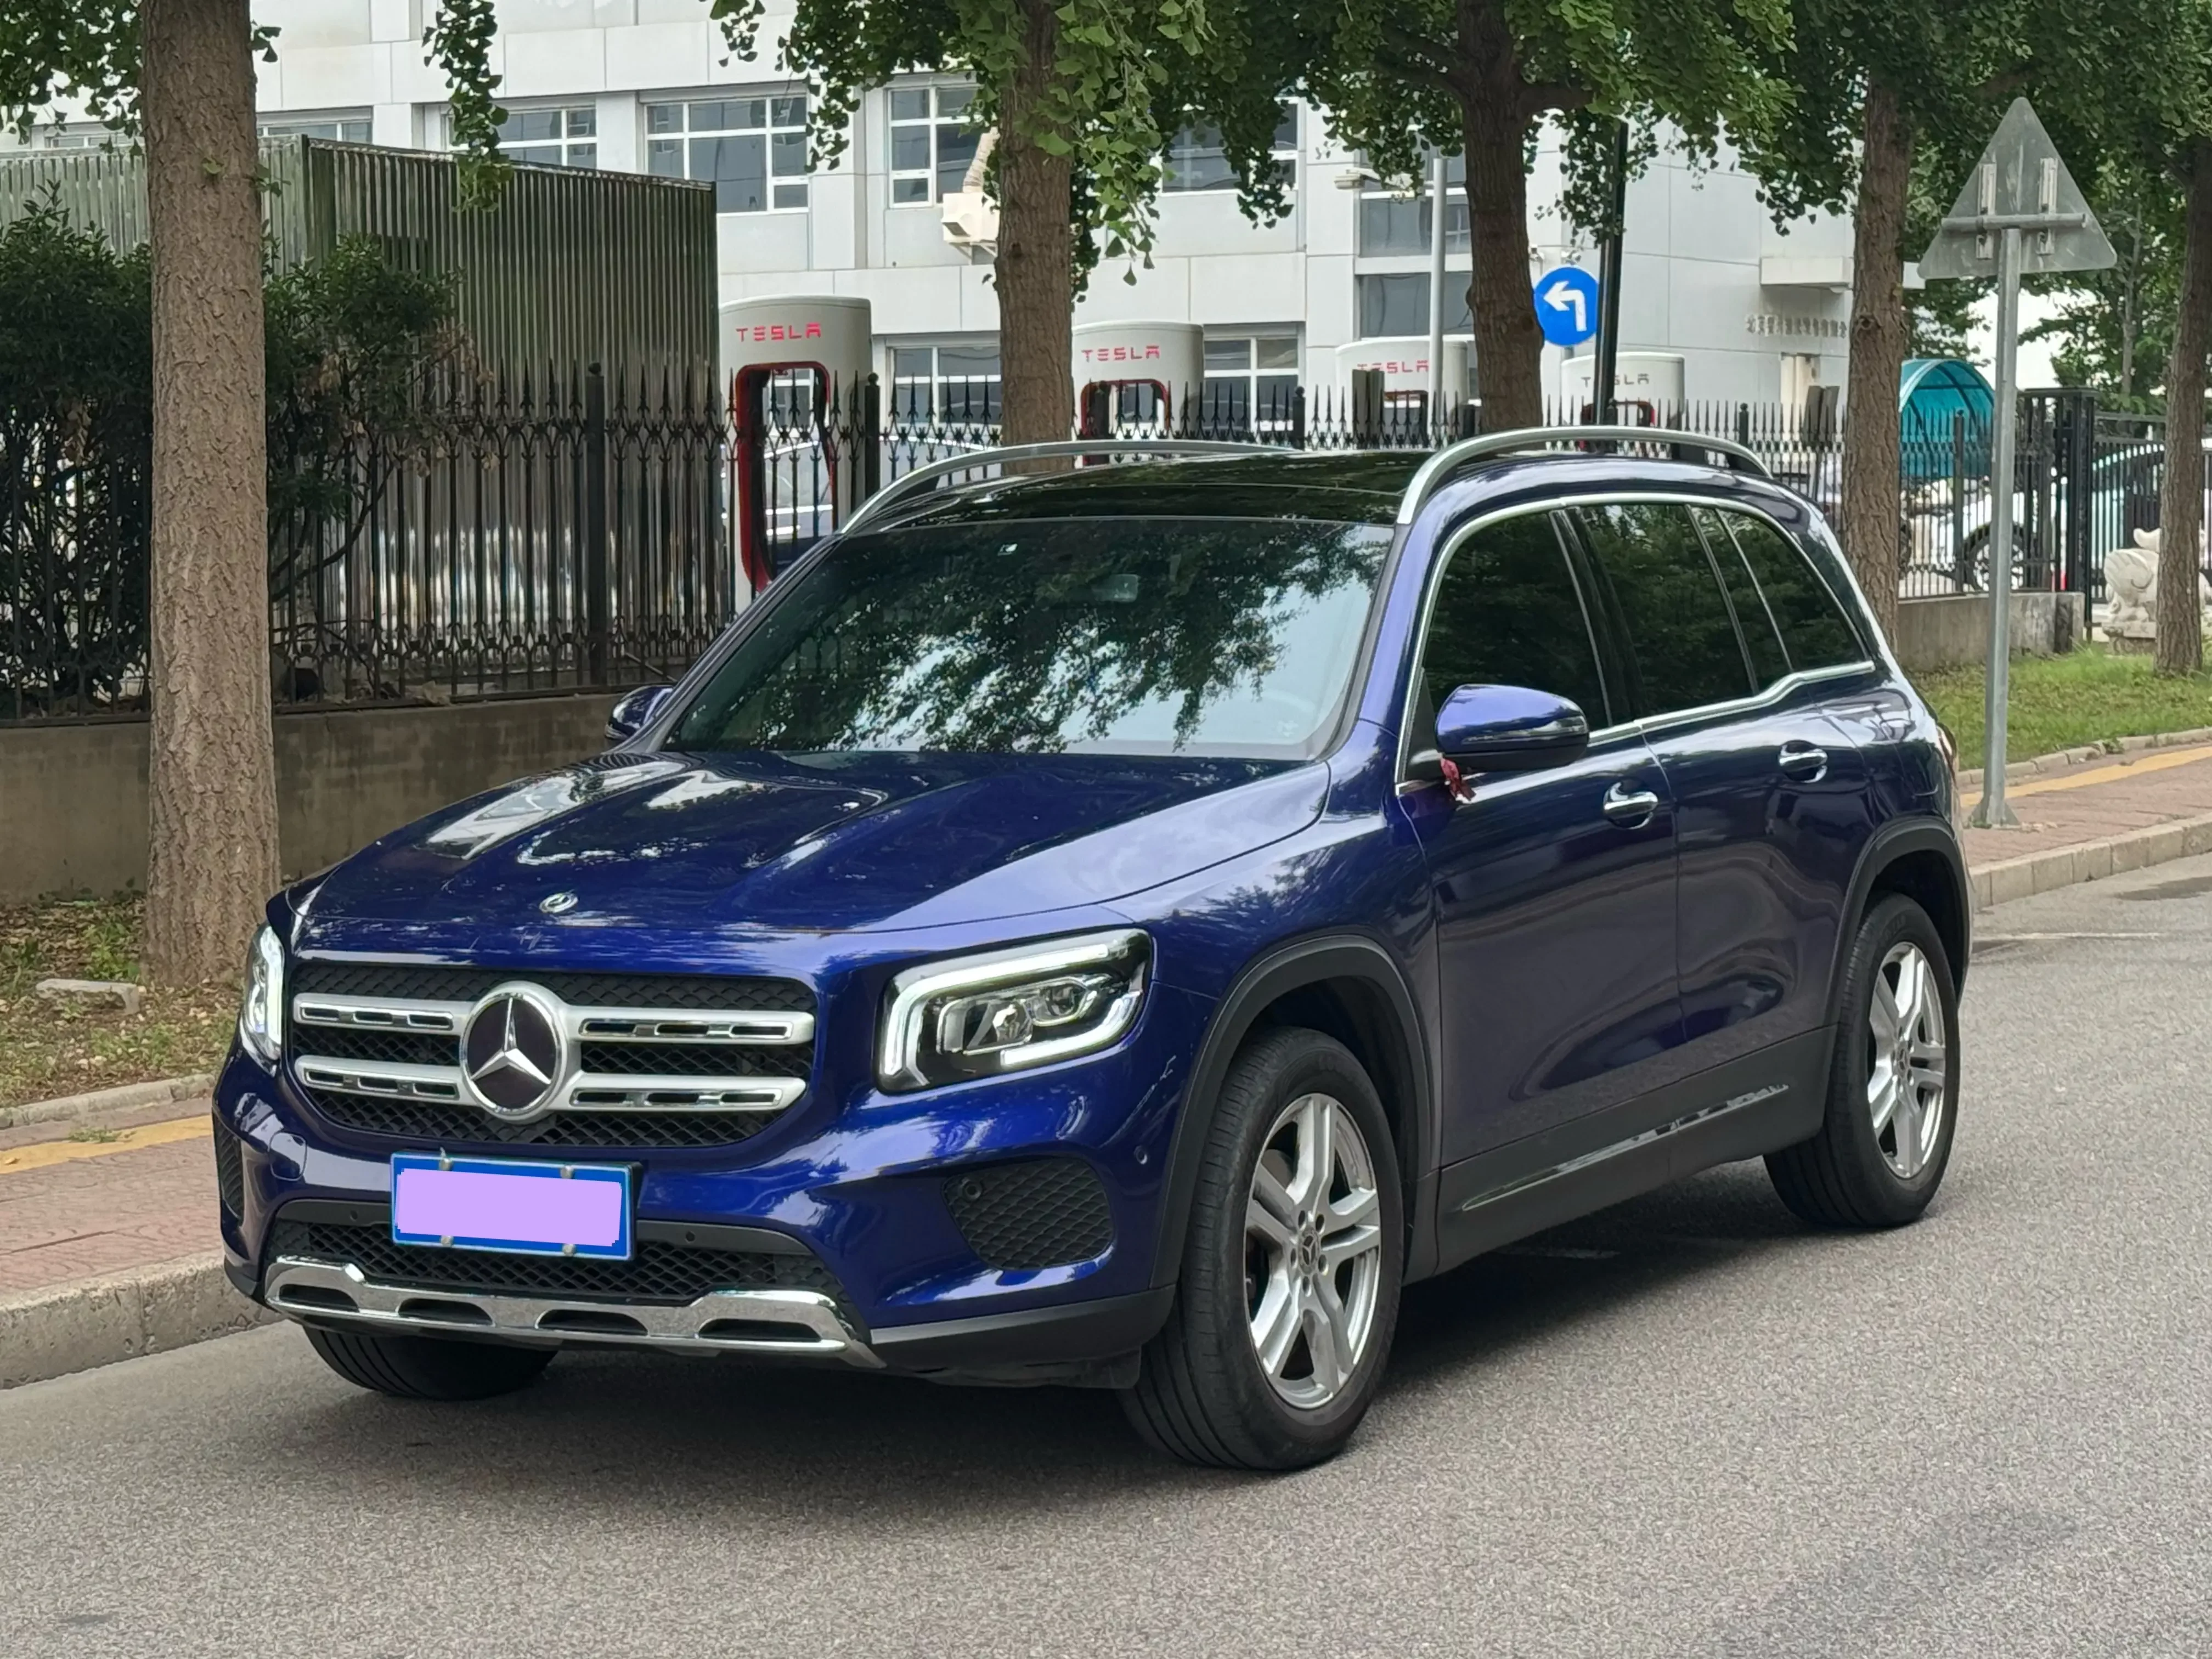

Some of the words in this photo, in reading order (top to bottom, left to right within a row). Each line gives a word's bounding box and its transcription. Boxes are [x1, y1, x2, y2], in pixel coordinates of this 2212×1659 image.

[736, 322, 821, 342] TESLA
[1081, 345, 1160, 363] TESLA
[1581, 373, 1649, 387] TSLA
